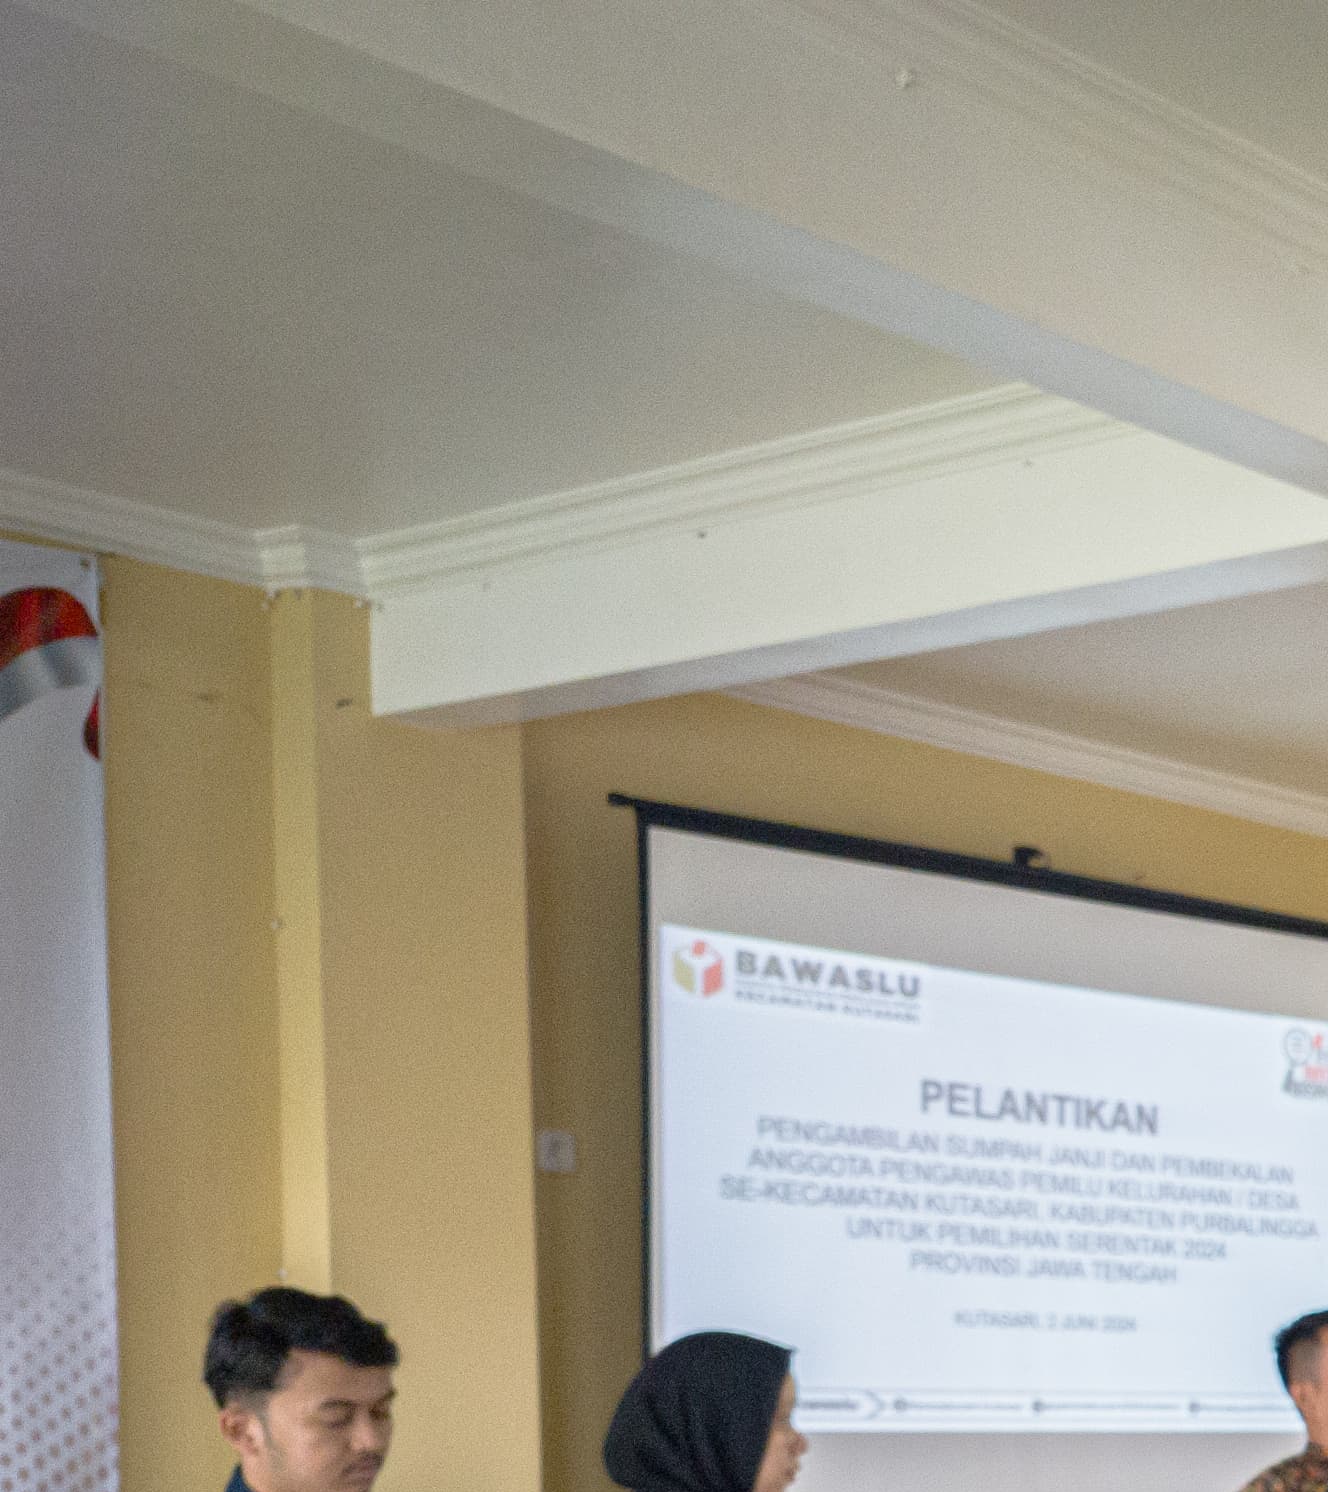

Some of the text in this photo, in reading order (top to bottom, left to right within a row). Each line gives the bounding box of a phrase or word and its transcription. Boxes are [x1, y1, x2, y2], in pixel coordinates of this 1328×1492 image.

[735, 949, 920, 998] BAWASLU
[920, 1078, 1159, 1137] PELANTIKAN
[757, 1114, 1295, 1184] PENGAMBILAN SUMPAH JANJI DAN PEMBEKALAN
[719, 1173, 918, 1211] SE-KECAMATAN
[1049, 1202, 1175, 1230] KABUPATEN
[1180, 1210, 1318, 1238] PURBALINGGA
[747, 1147, 874, 1178] ANGGOTA
[879, 1156, 1015, 1190] PENGAWAS
[1020, 1169, 1101, 1197] PEMILU
[1107, 1176, 1232, 1206] KELURAHAN
[1248, 1188, 1300, 1211] DESA
[846, 1215, 1227, 1260] UNTUK PEMILIHAN SERENTAK 2024
[909, 1249, 1178, 1284] PROVINSI JAWA TENGAH
